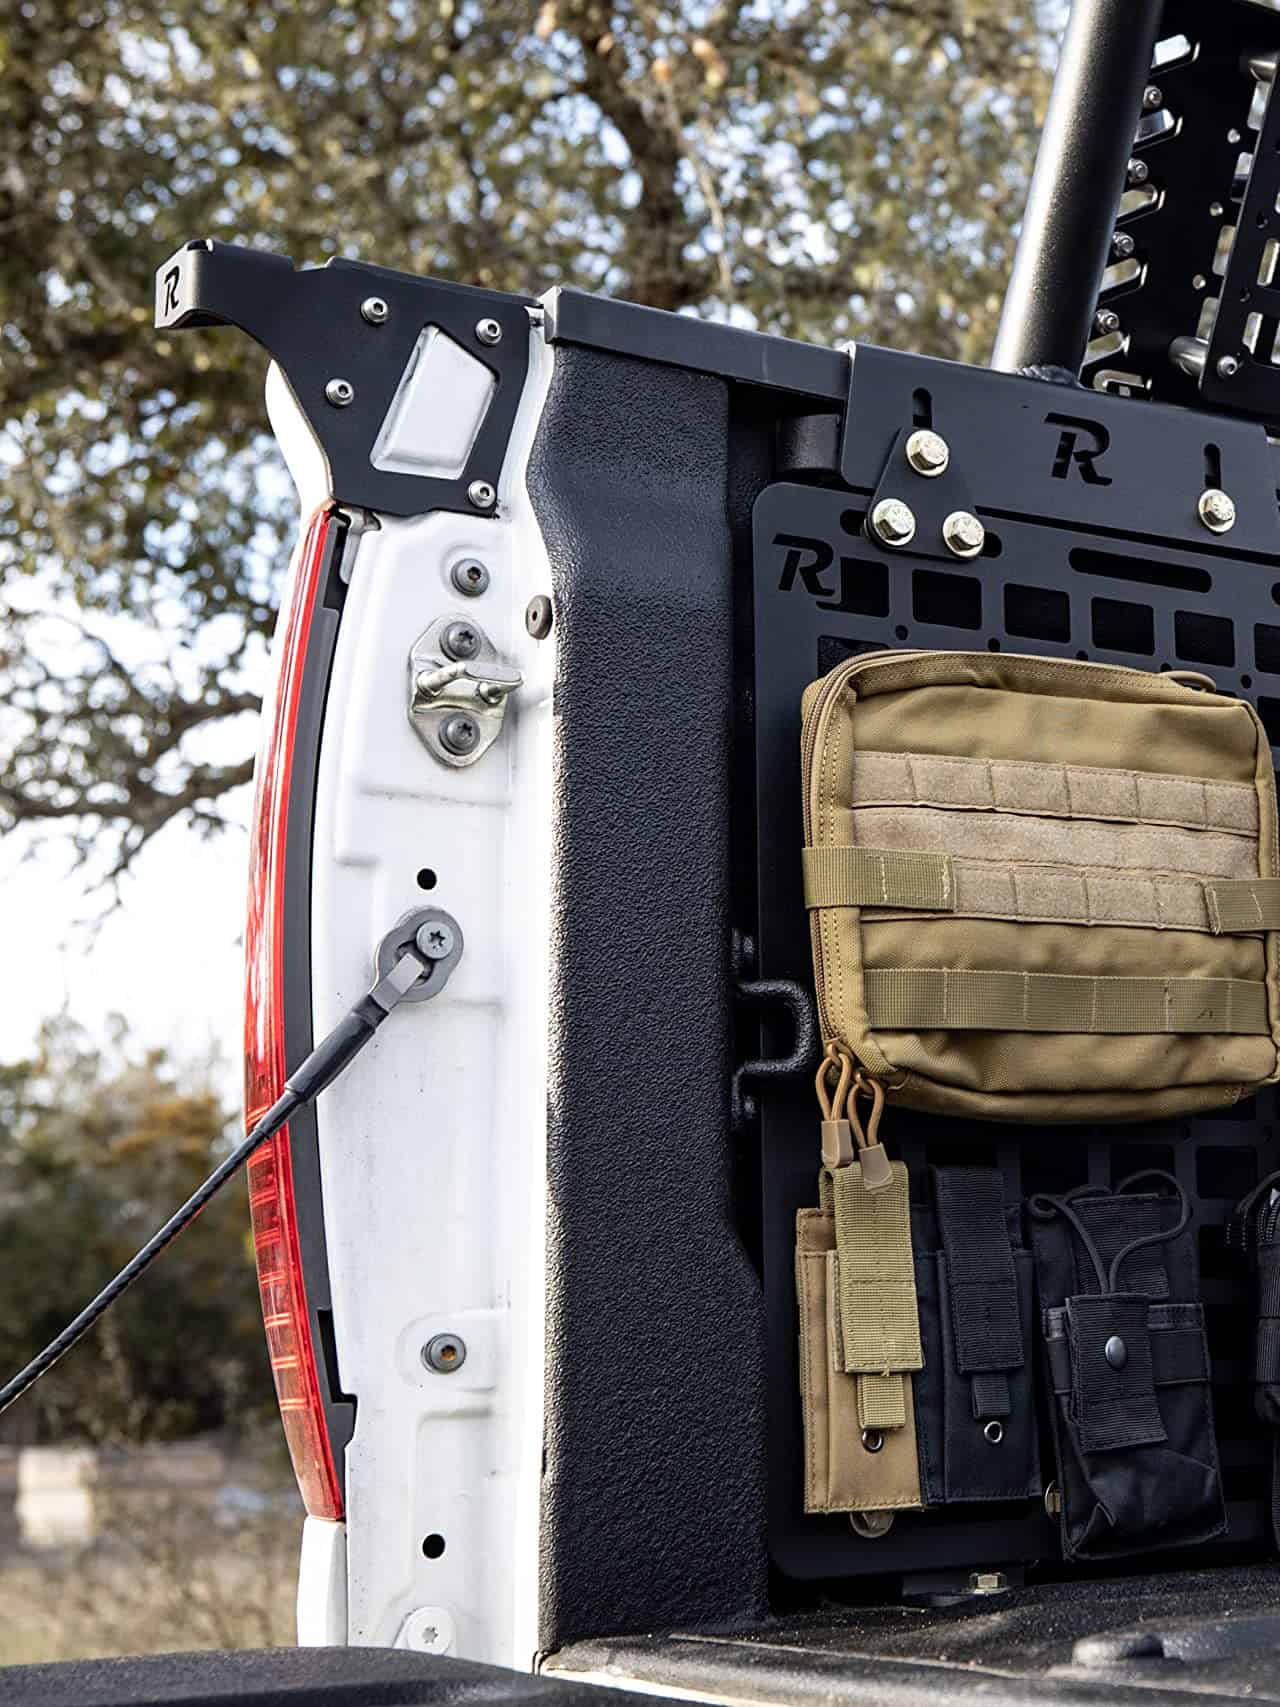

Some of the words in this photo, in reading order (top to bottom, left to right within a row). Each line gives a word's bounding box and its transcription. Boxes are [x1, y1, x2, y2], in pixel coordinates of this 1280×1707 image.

[164, 265, 179, 317] R
[1043, 411, 1112, 486] R
[771, 532, 835, 597] R
